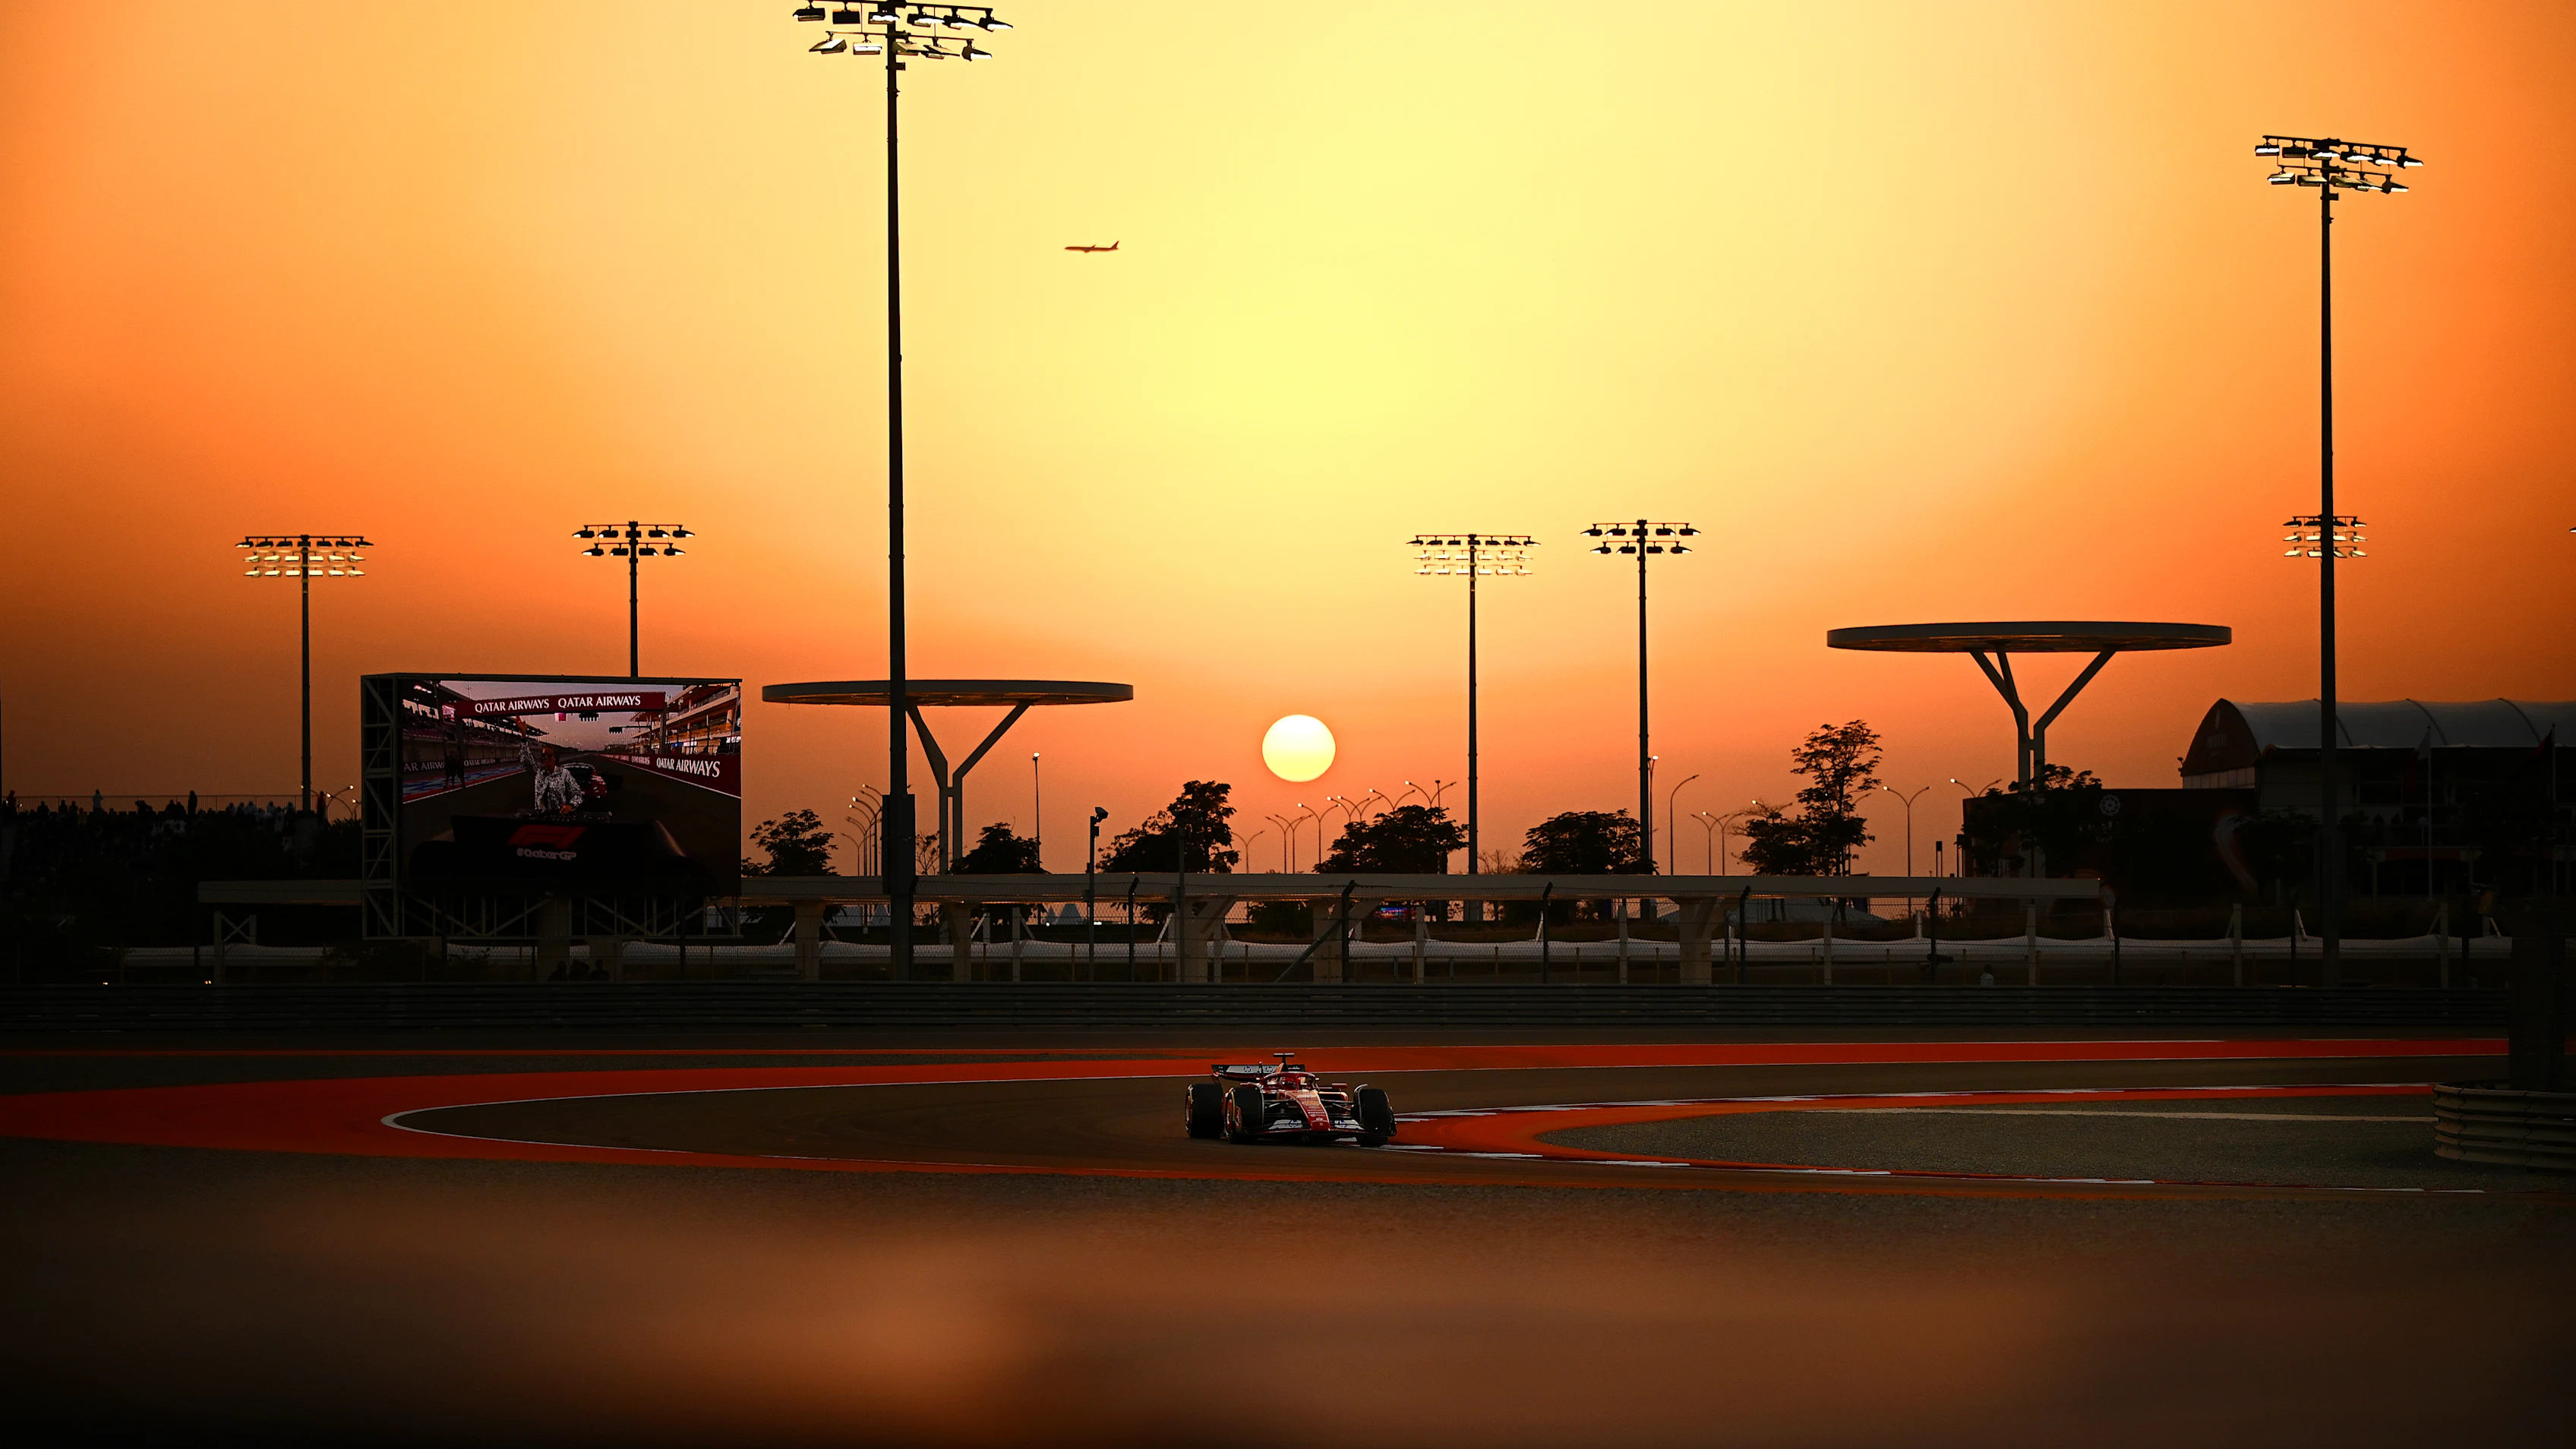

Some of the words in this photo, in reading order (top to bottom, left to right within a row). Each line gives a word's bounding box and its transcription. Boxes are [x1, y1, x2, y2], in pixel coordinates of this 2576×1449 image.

[475, 701, 506, 714] QATAR
[508, 698, 550, 712] AIRWAYS
[557, 695, 593, 709] QATAR
[595, 694, 641, 707] AIRWAYS
[656, 757, 675, 770] QATAR
[676, 758, 721, 778] AIRWAYS
